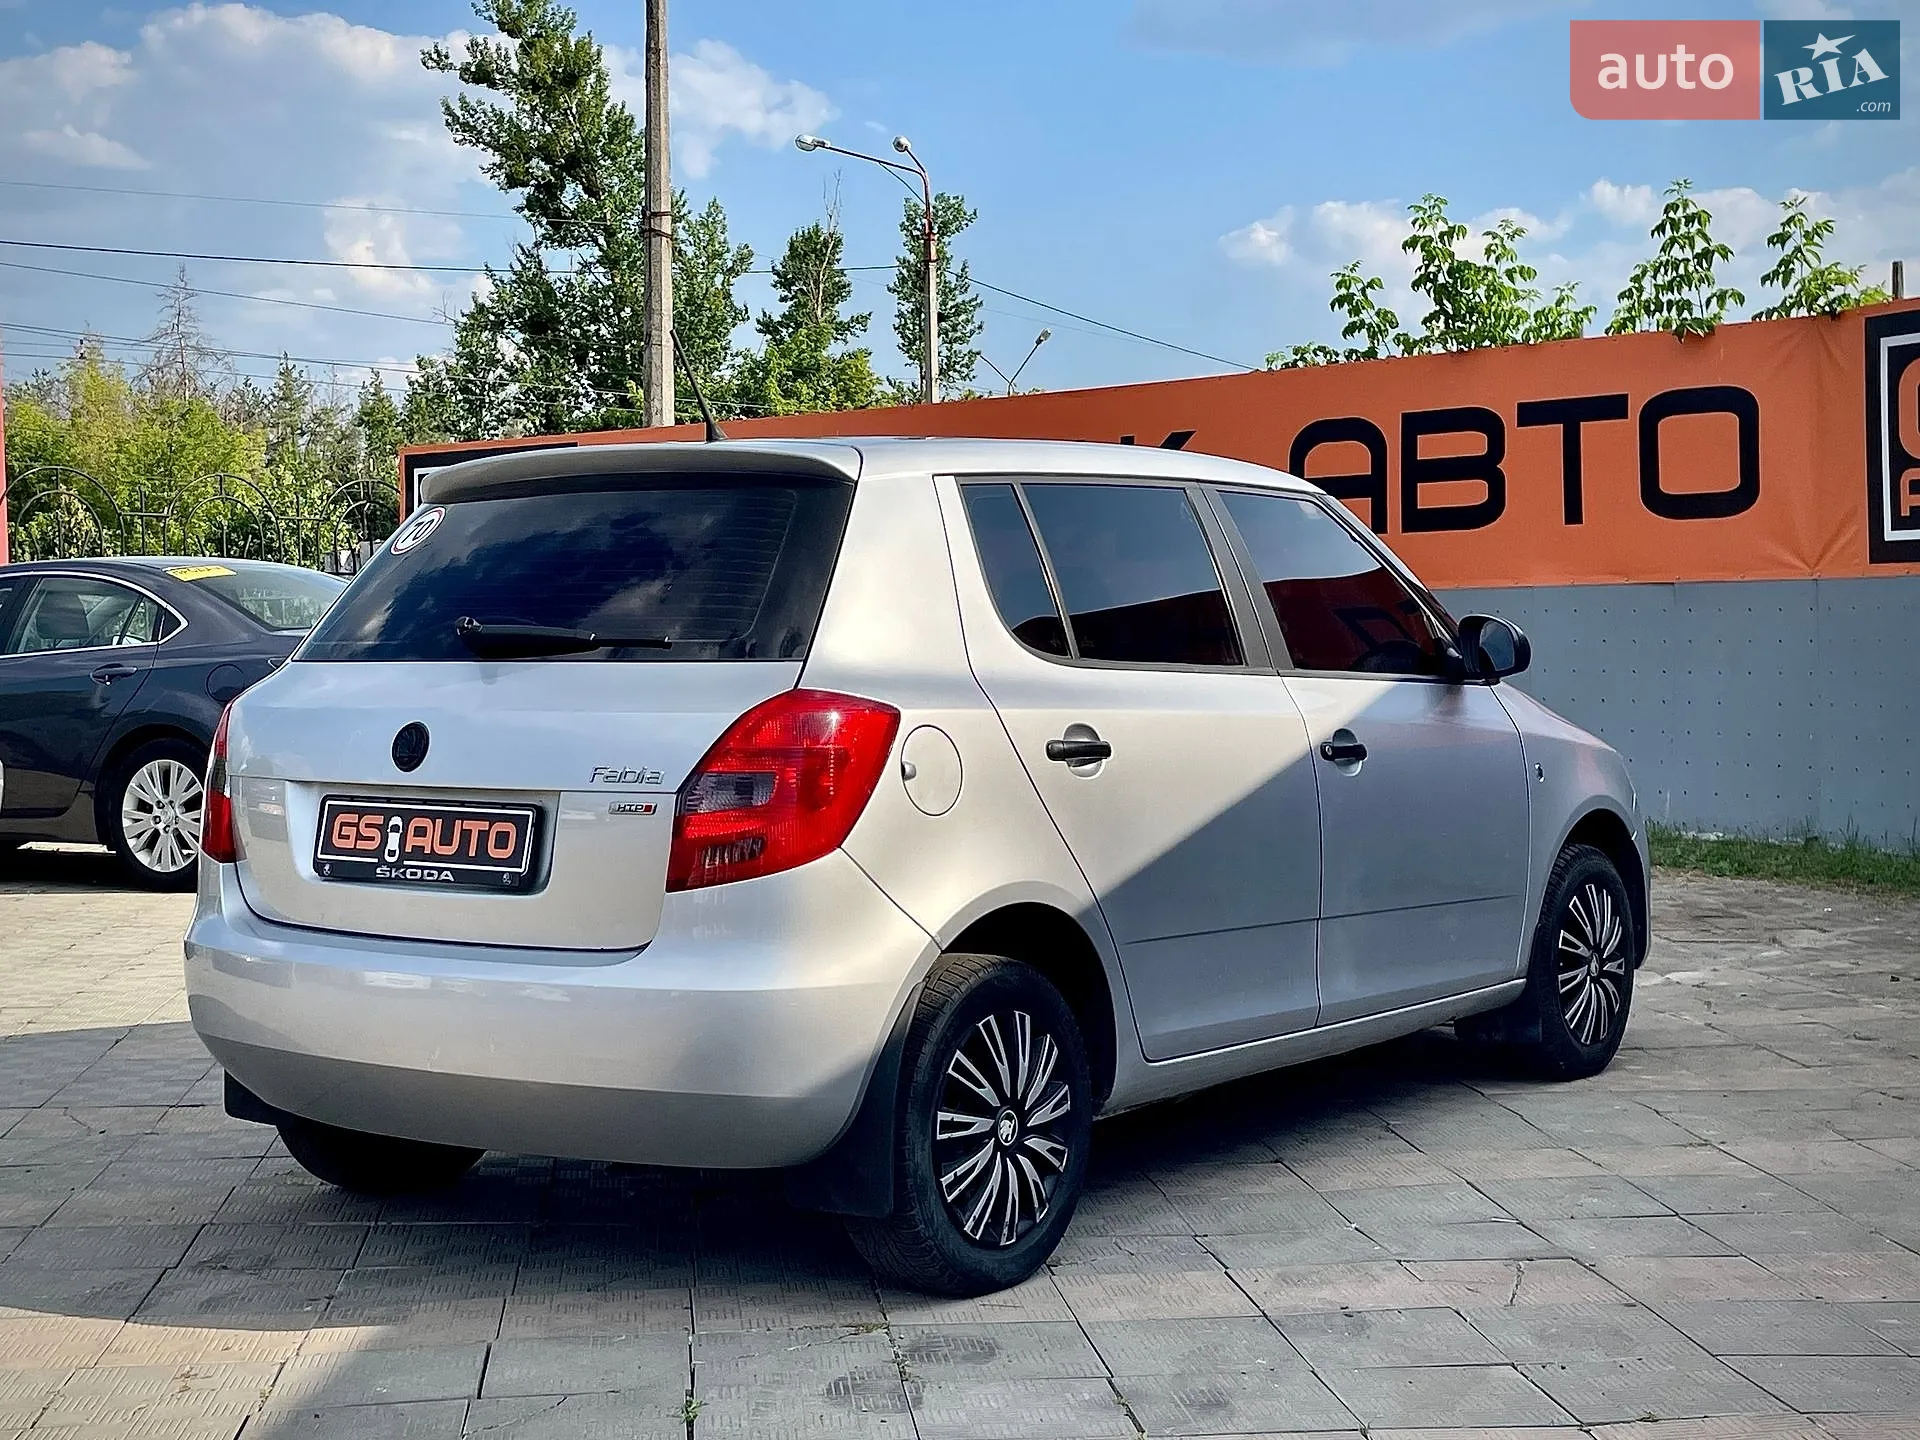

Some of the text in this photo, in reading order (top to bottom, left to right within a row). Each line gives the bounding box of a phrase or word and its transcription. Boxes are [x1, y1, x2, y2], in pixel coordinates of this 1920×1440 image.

[1288, 384, 1760, 534] АВТО
[401, 519, 434, 543] 70
[589, 766, 664, 784] Fabia
[617, 803, 644, 813] HTP
[332, 814, 517, 859] GS AUTO
[375, 865, 455, 882] ŠKODA
